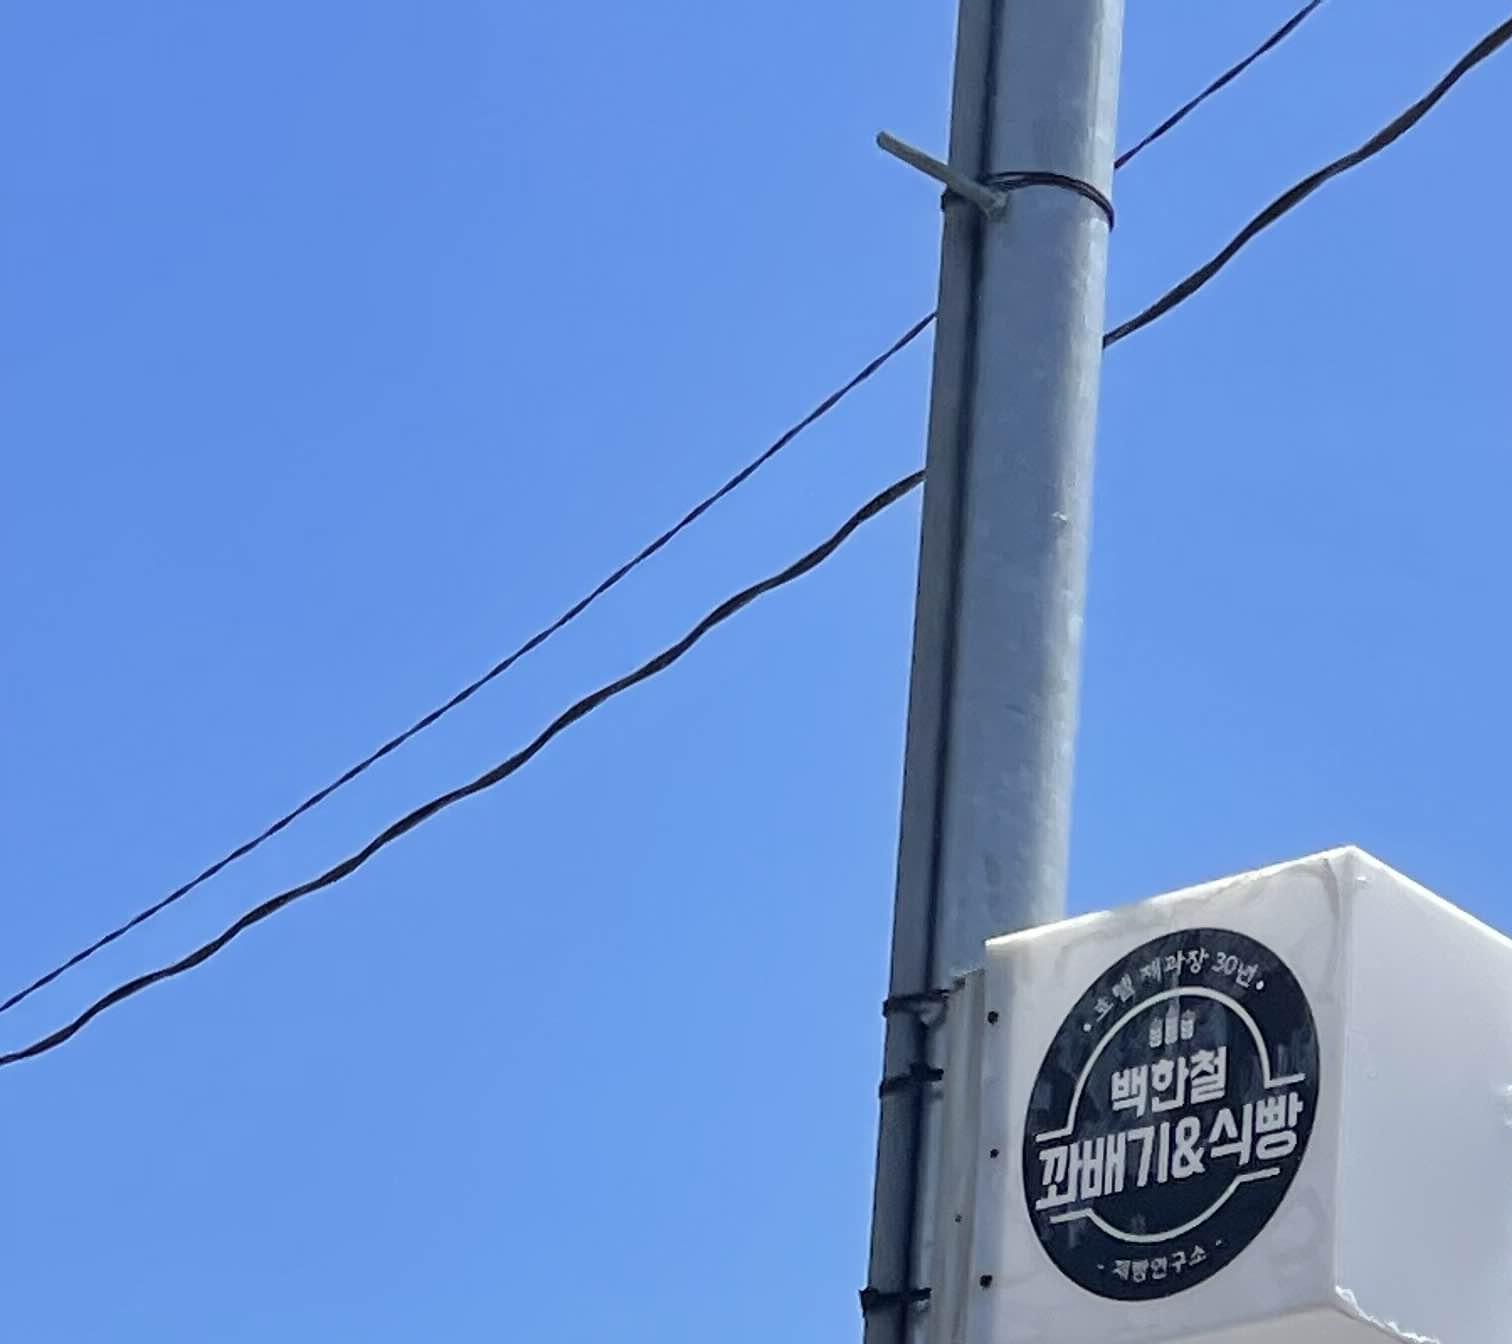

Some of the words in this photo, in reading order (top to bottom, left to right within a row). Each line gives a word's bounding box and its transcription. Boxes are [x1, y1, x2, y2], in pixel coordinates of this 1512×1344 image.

[1211, 951, 1258, 989] 30년
[1111, 1046, 1227, 1118] 백한철
[1035, 1092, 1304, 1210] 꽈배기&식빵
